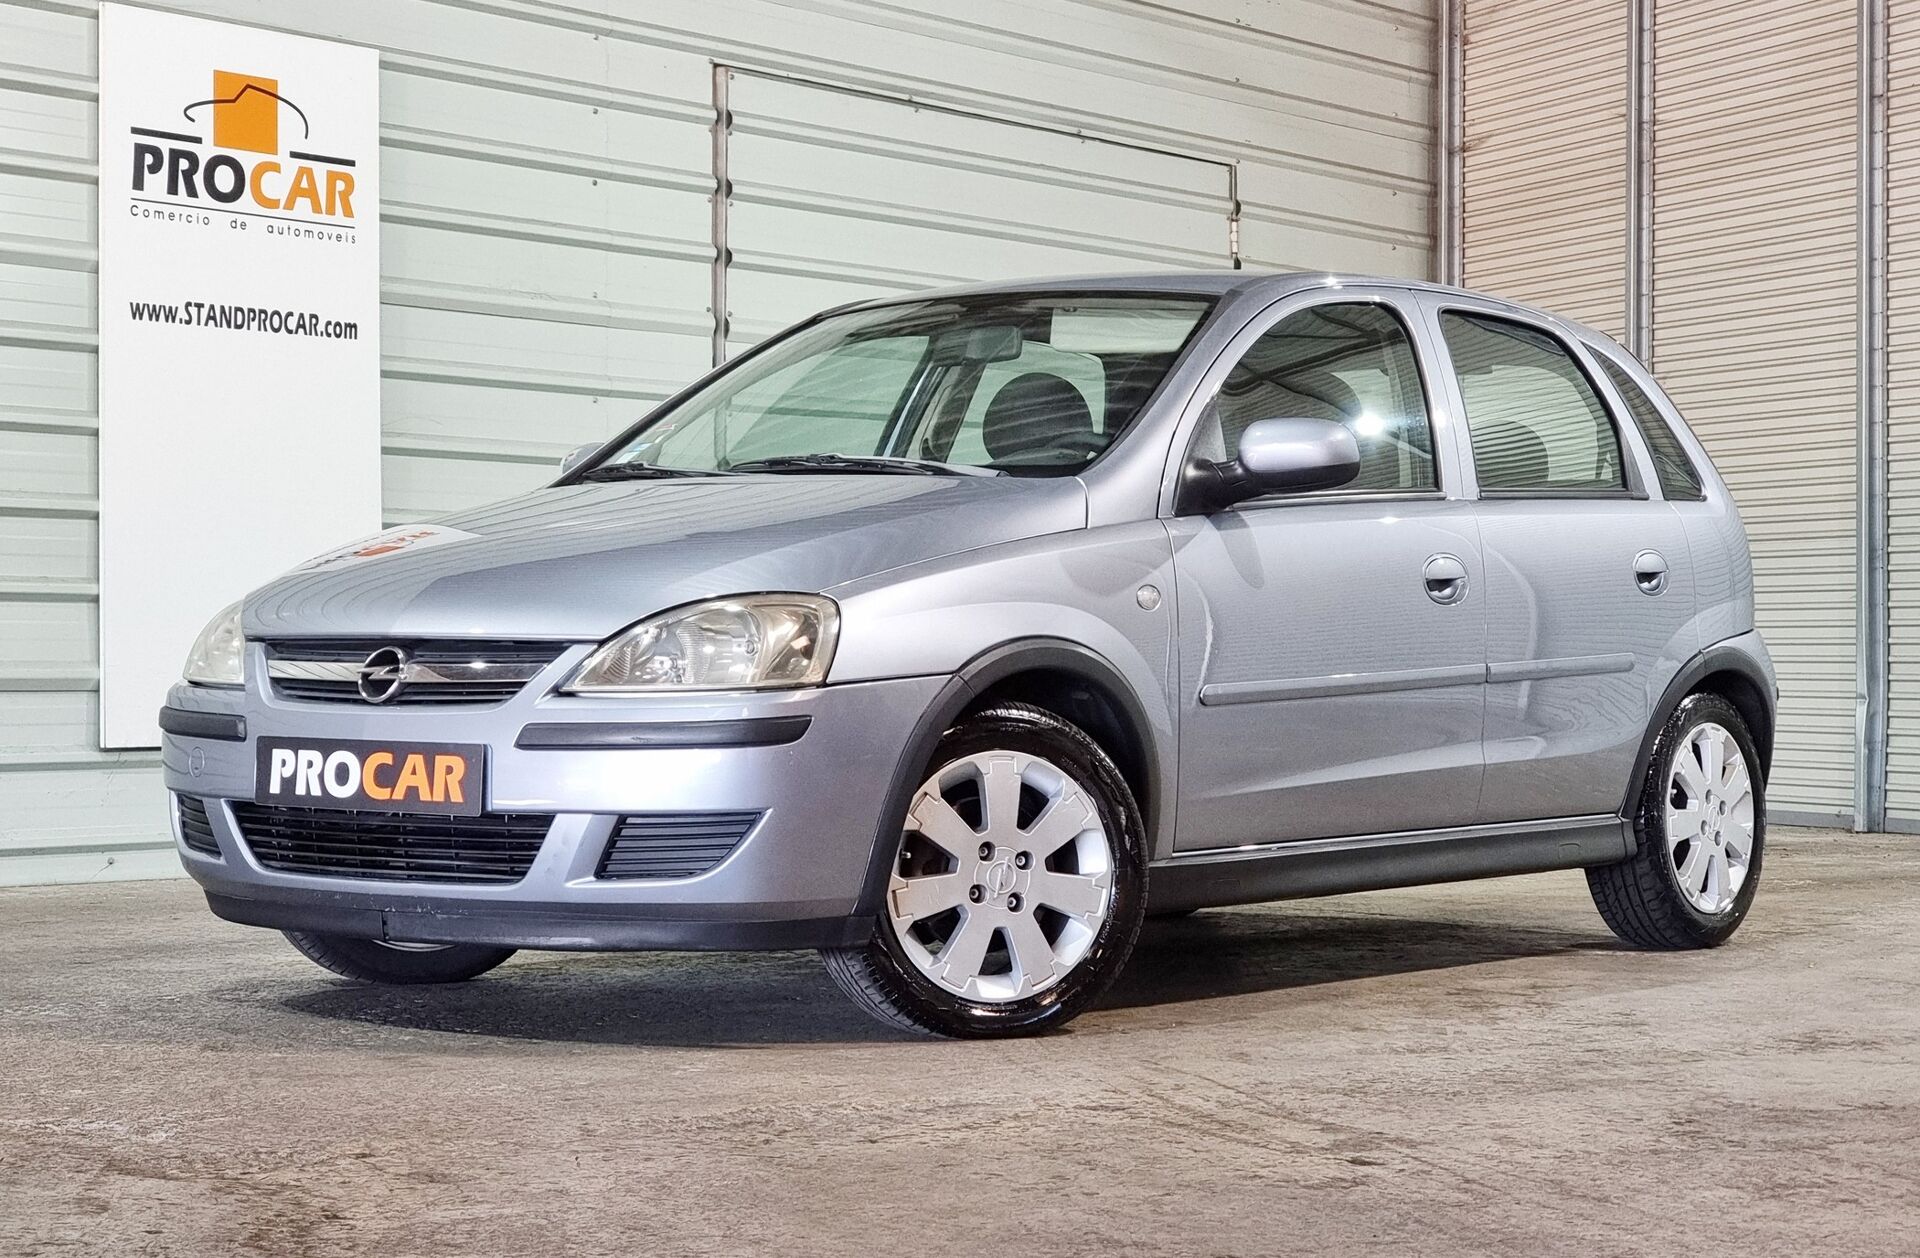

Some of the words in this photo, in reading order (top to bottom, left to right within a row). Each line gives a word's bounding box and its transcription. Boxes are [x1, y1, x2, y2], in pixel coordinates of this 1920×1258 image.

[131, 142, 355, 219] PROCAR
[130, 204, 210, 226] Comercio
[230, 218, 247, 230] de
[266, 224, 356, 244] automoveis
[129, 301, 358, 340] www.STANDPROCAR.com
[269, 748, 465, 803] PROCAR
